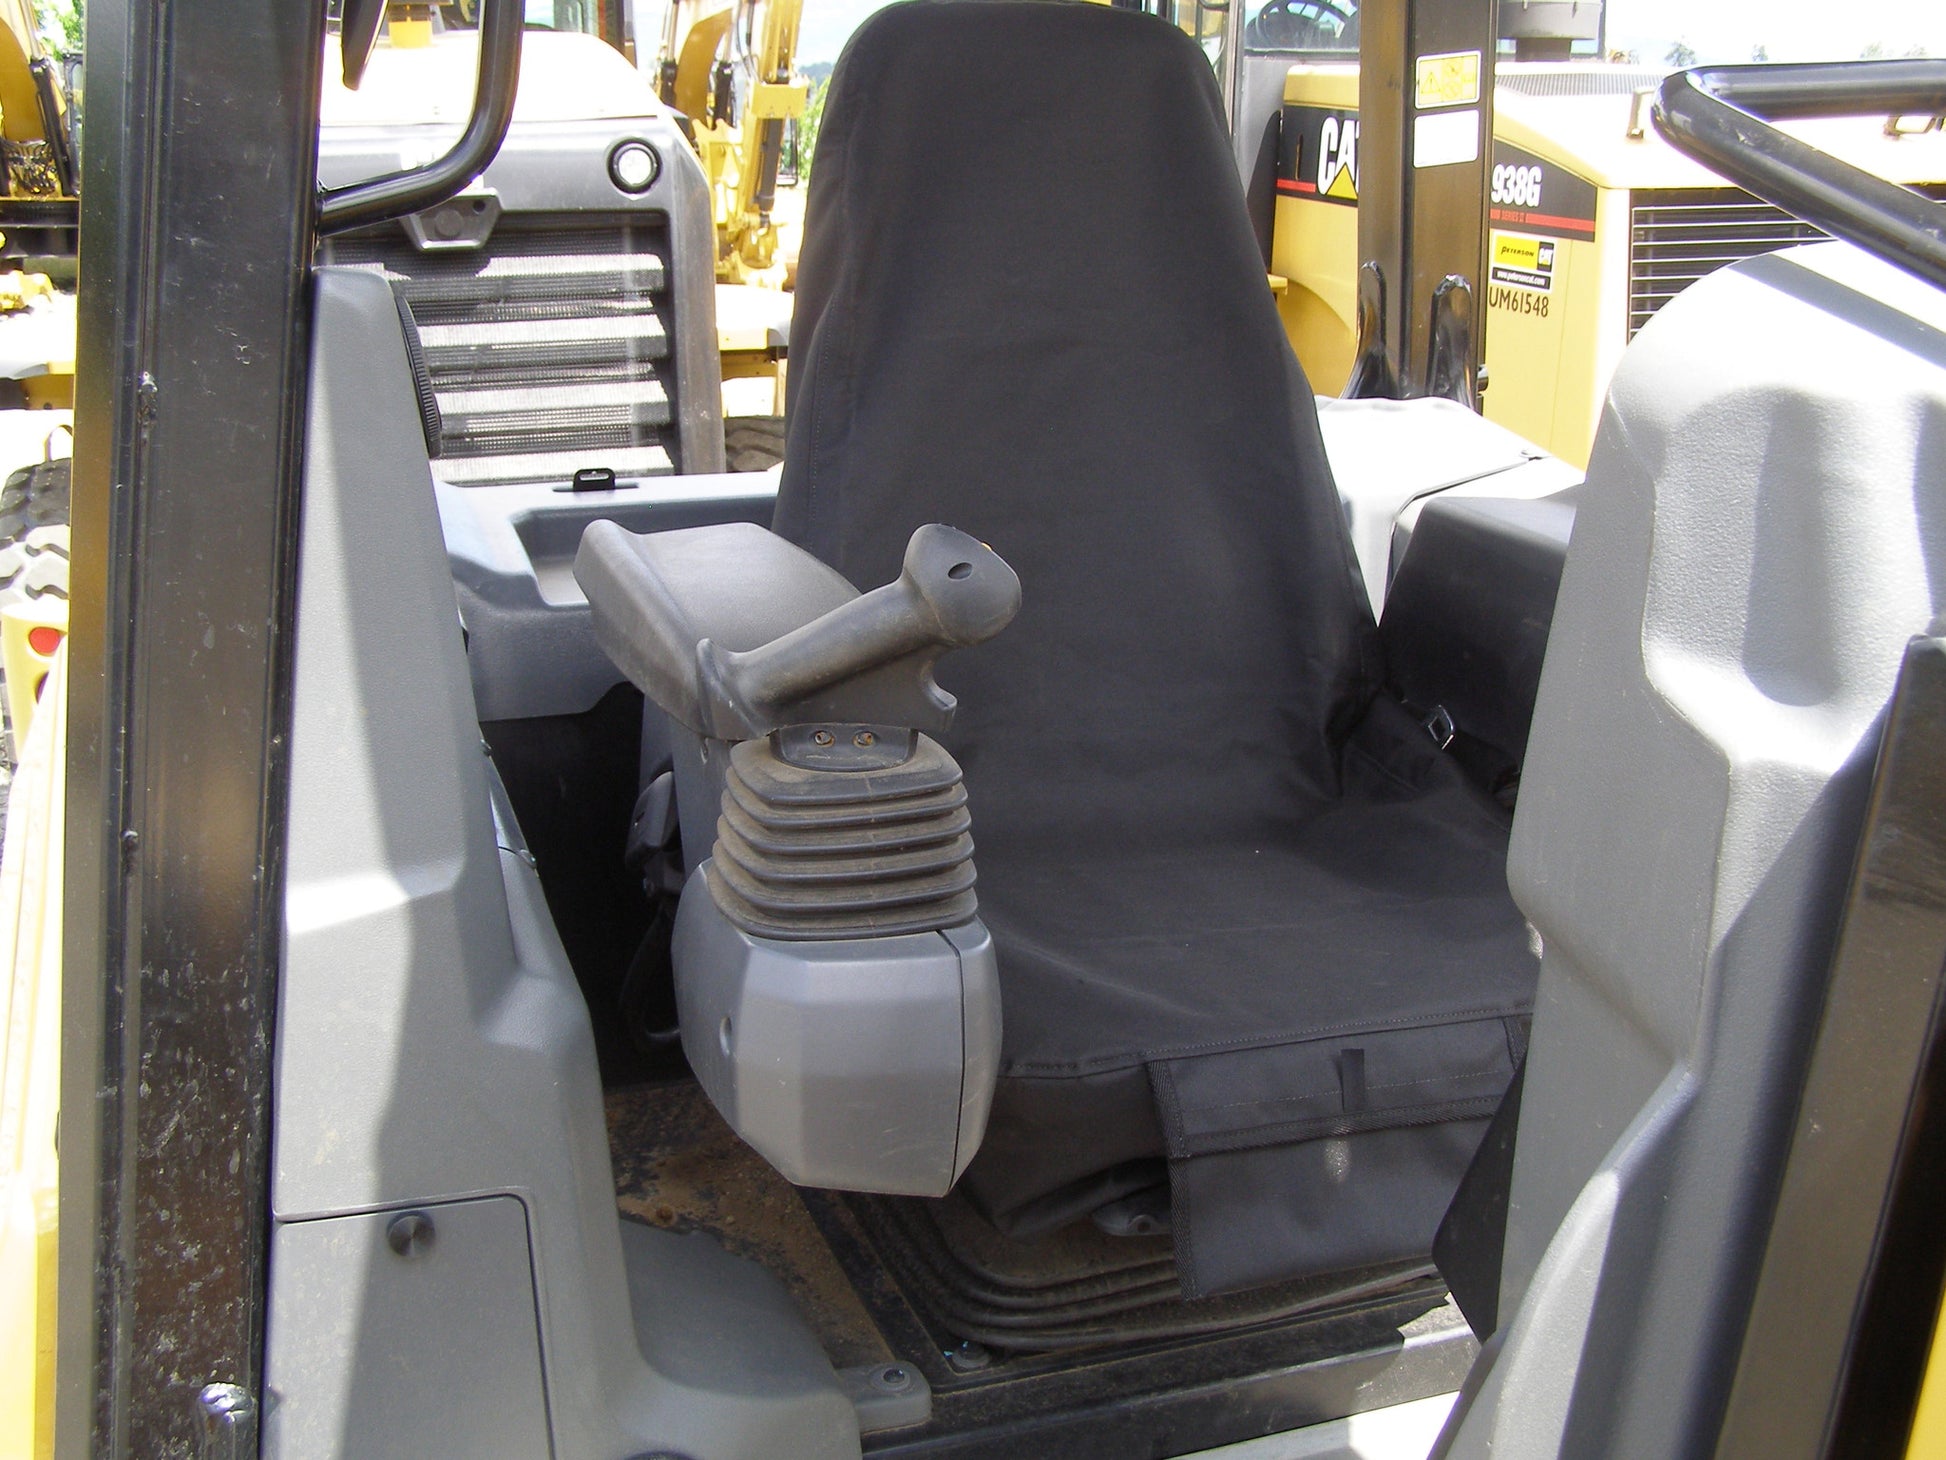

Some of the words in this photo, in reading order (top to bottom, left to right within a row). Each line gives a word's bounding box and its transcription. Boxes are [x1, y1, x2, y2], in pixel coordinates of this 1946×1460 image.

[1318, 116, 1359, 196] CA
[1491, 164, 1542, 207] 938G
[1501, 246, 1535, 257] PETERSON
[1538, 247, 1553, 266] CAT
[1489, 286, 1549, 317] UM61548
